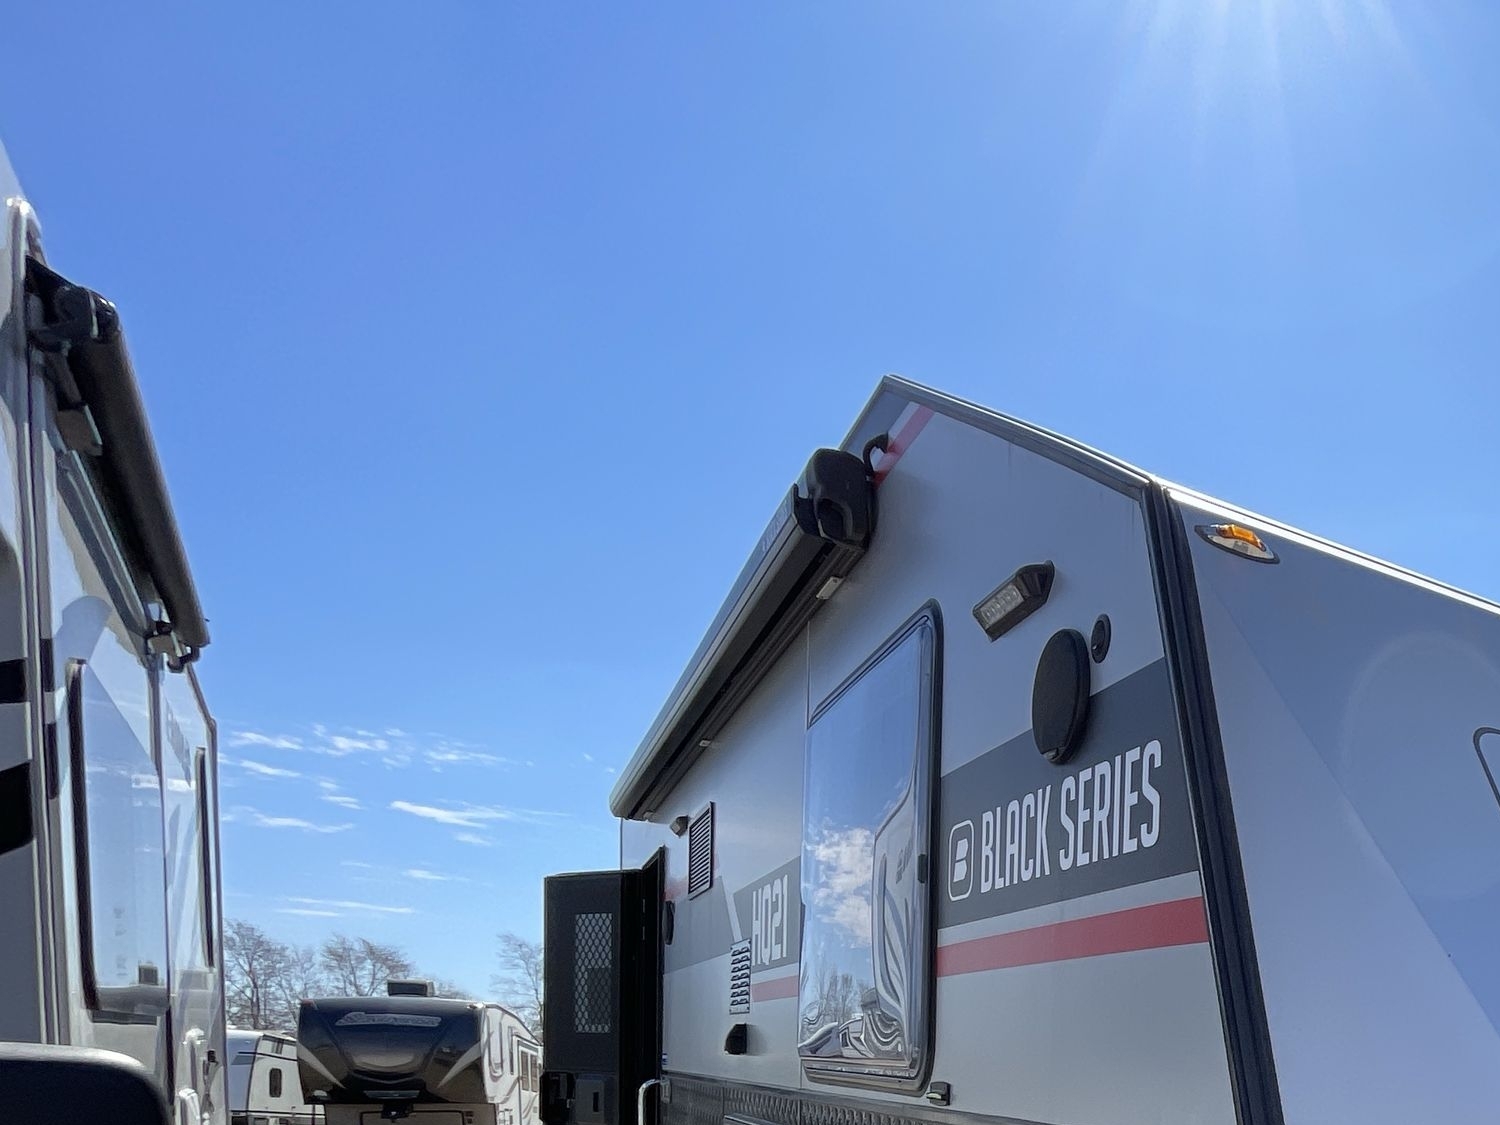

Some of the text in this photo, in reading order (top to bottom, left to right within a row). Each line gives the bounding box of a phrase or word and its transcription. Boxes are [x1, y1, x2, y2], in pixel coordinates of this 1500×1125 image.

[980, 784, 1052, 894] BLACK
[1058, 739, 1162, 871] SERIES
[751, 873, 788, 967] HQ21
